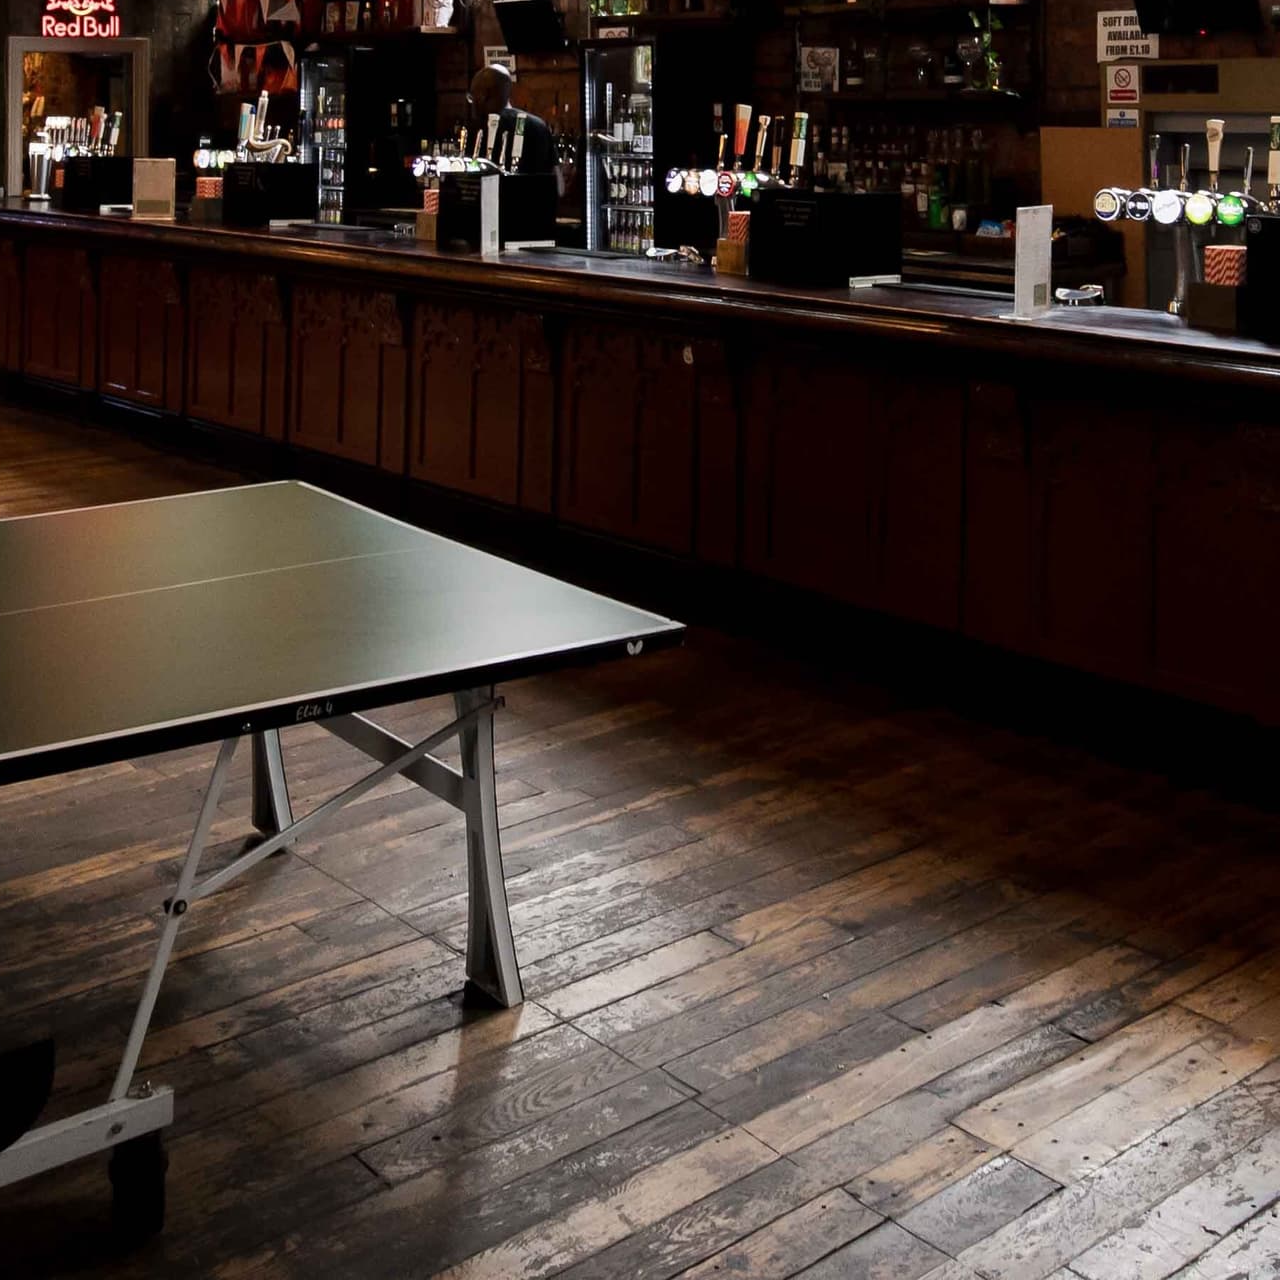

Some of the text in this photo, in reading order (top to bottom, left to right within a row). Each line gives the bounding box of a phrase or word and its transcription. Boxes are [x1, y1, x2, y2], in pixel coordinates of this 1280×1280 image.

[42, 15, 120, 38] Red Bull
[1102, 15, 1140, 27] SOFT DRI
[1106, 45, 1127, 56] FROM
